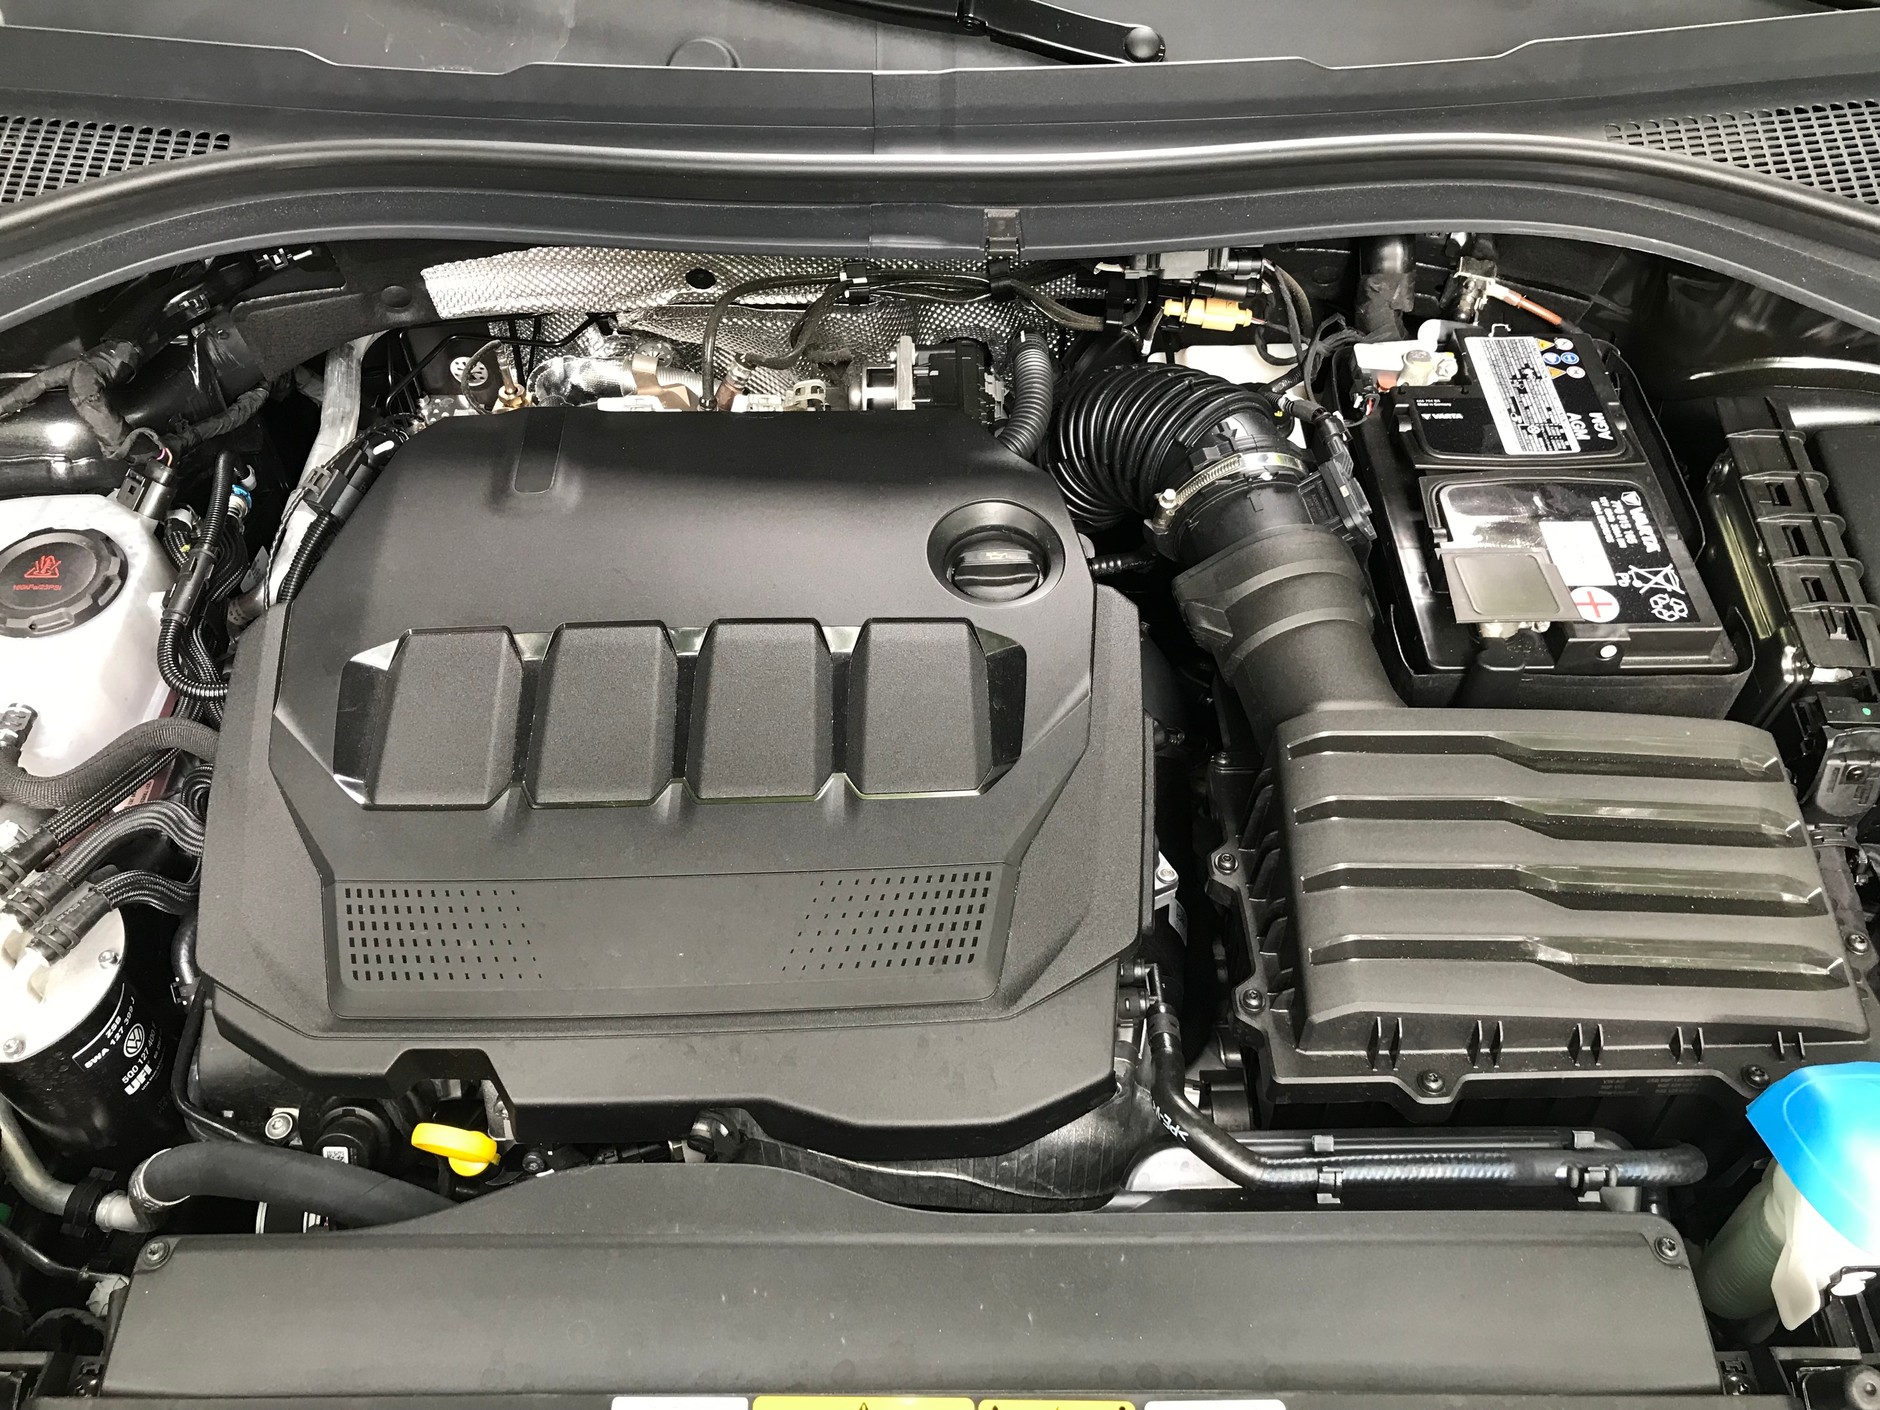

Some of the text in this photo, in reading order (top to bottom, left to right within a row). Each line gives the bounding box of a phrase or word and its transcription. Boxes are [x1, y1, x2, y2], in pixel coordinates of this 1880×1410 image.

[1431, 412, 1464, 420] VARTA
[1566, 412, 1591, 440] AGM
[1588, 412, 1614, 440] AGM
[1629, 506, 1661, 553] VARTA
[1615, 572, 1631, 587] Pb
[105, 1015, 121, 1039] ZSB
[110, 1025, 124, 1046] 127
[121, 1064, 139, 1084] 5Q0
[138, 1046, 149, 1065] 127
[124, 1063, 153, 1096] UFI
